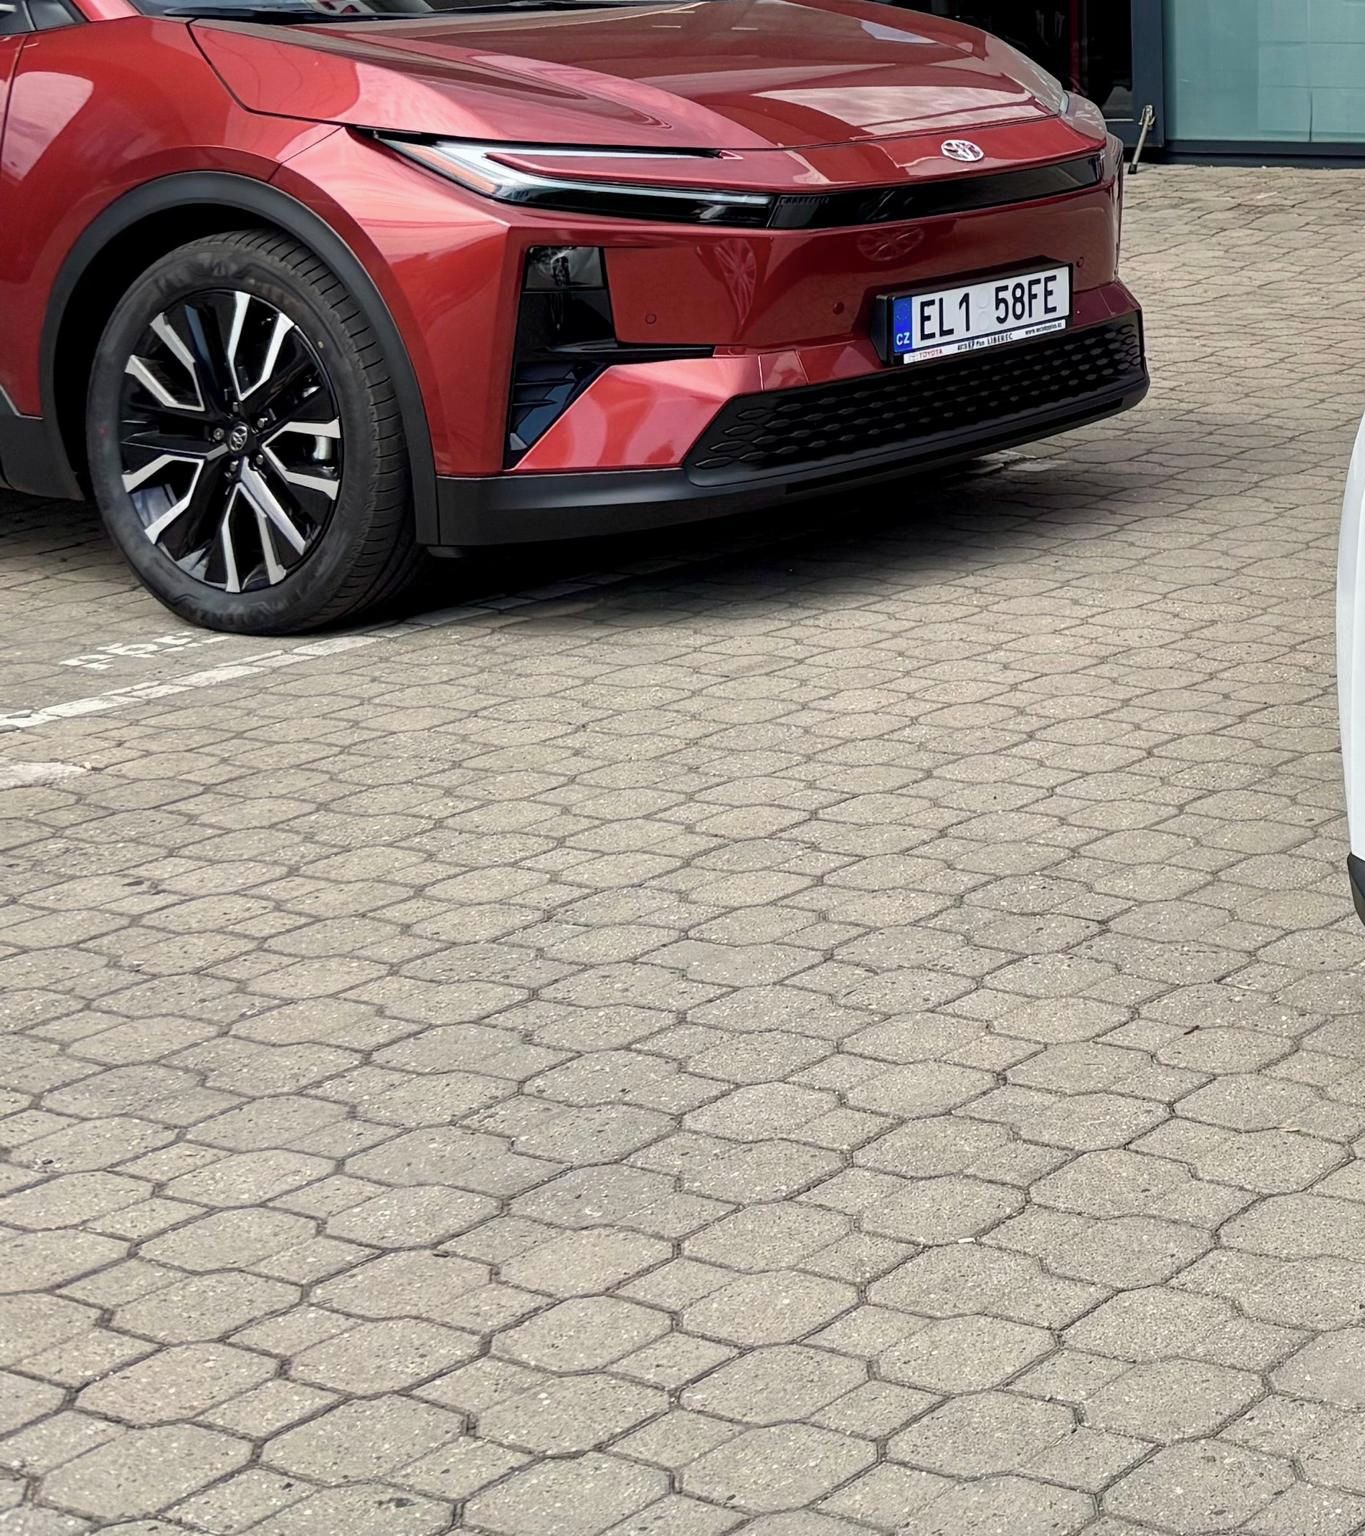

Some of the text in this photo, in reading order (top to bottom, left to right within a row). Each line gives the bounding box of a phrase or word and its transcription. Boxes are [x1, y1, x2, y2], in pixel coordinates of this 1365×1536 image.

[919, 275, 1057, 341] EL1 58FE
[896, 331, 910, 345] CZ
[919, 348, 944, 360] TOYOTA
[987, 333, 1013, 345] LIBEREC
